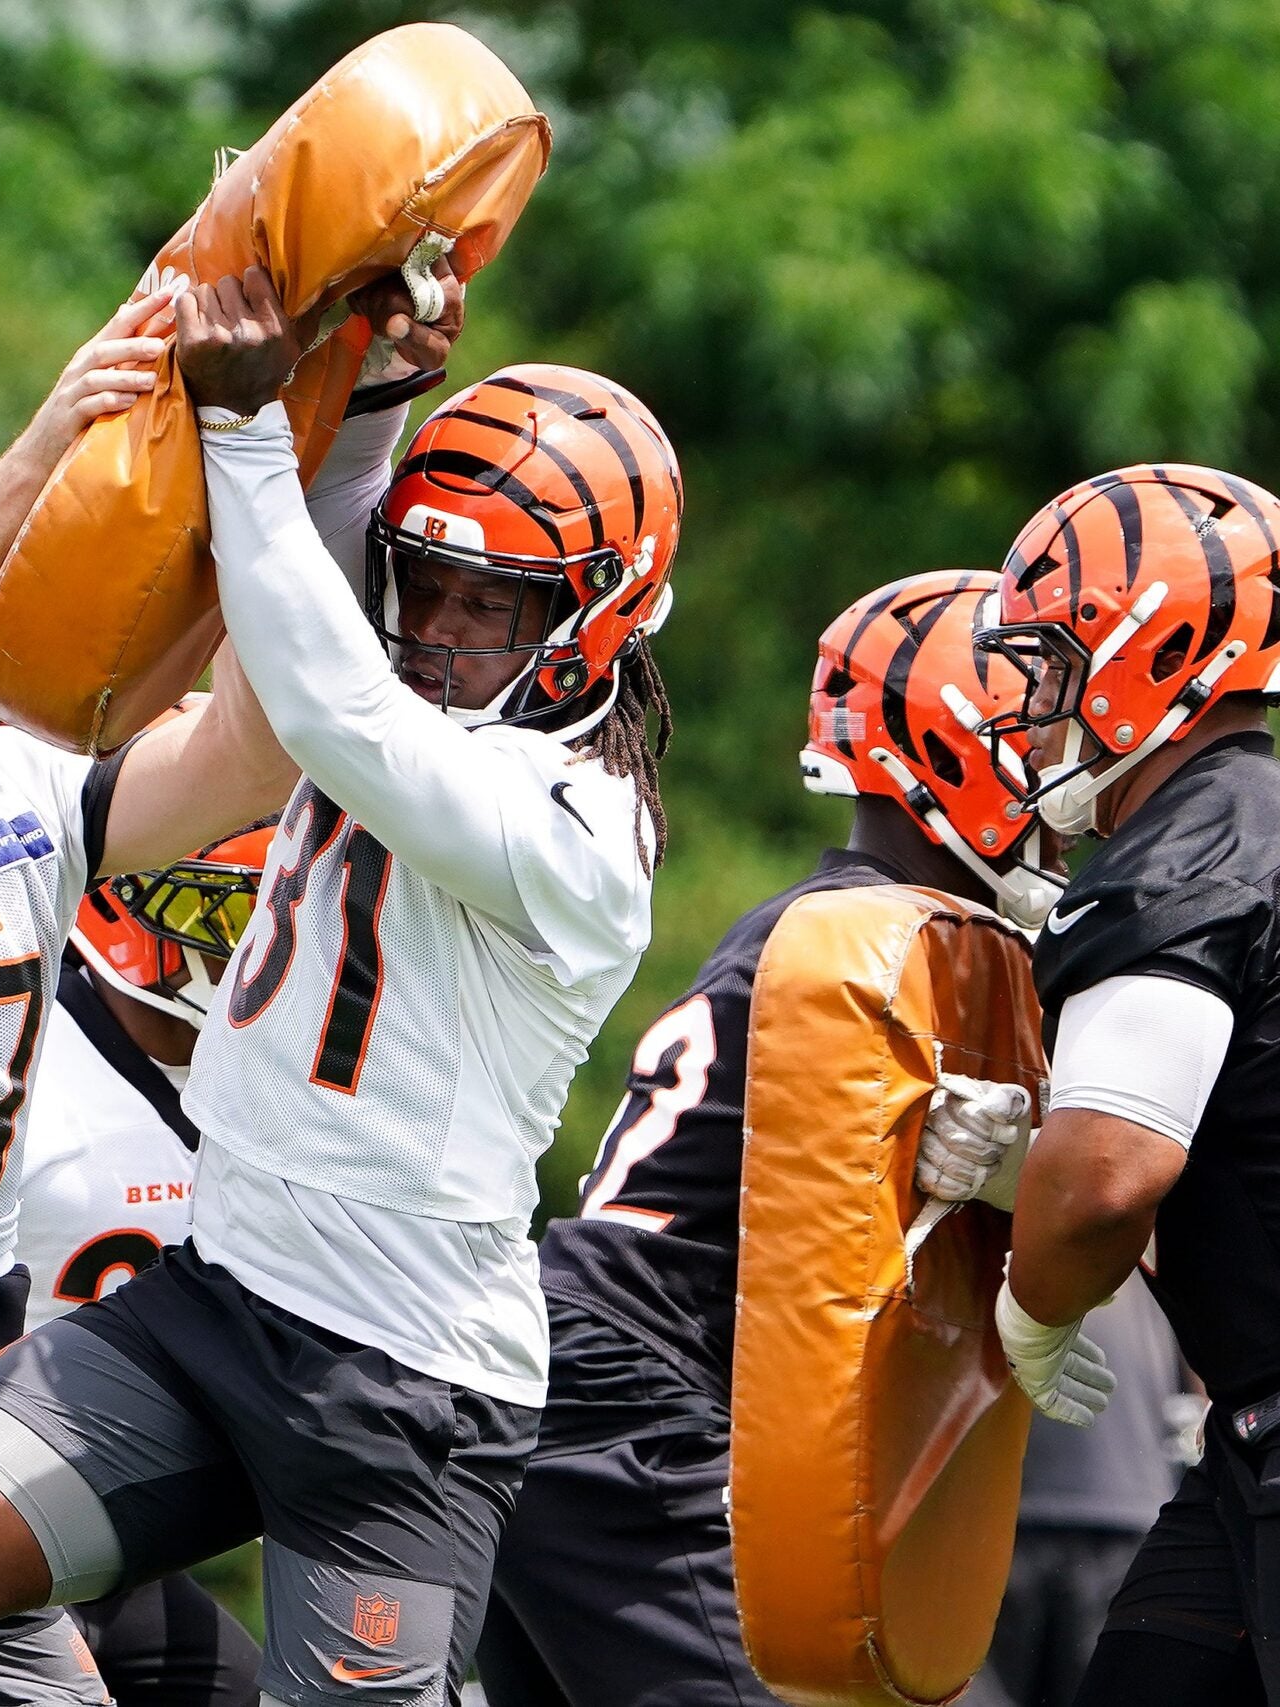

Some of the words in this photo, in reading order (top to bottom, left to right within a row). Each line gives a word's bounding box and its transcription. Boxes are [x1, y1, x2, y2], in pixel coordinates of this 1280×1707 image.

[578, 992, 718, 1234] 2
[126, 1182, 193, 1204] BEN
[358, 1614, 392, 1640] NFL
